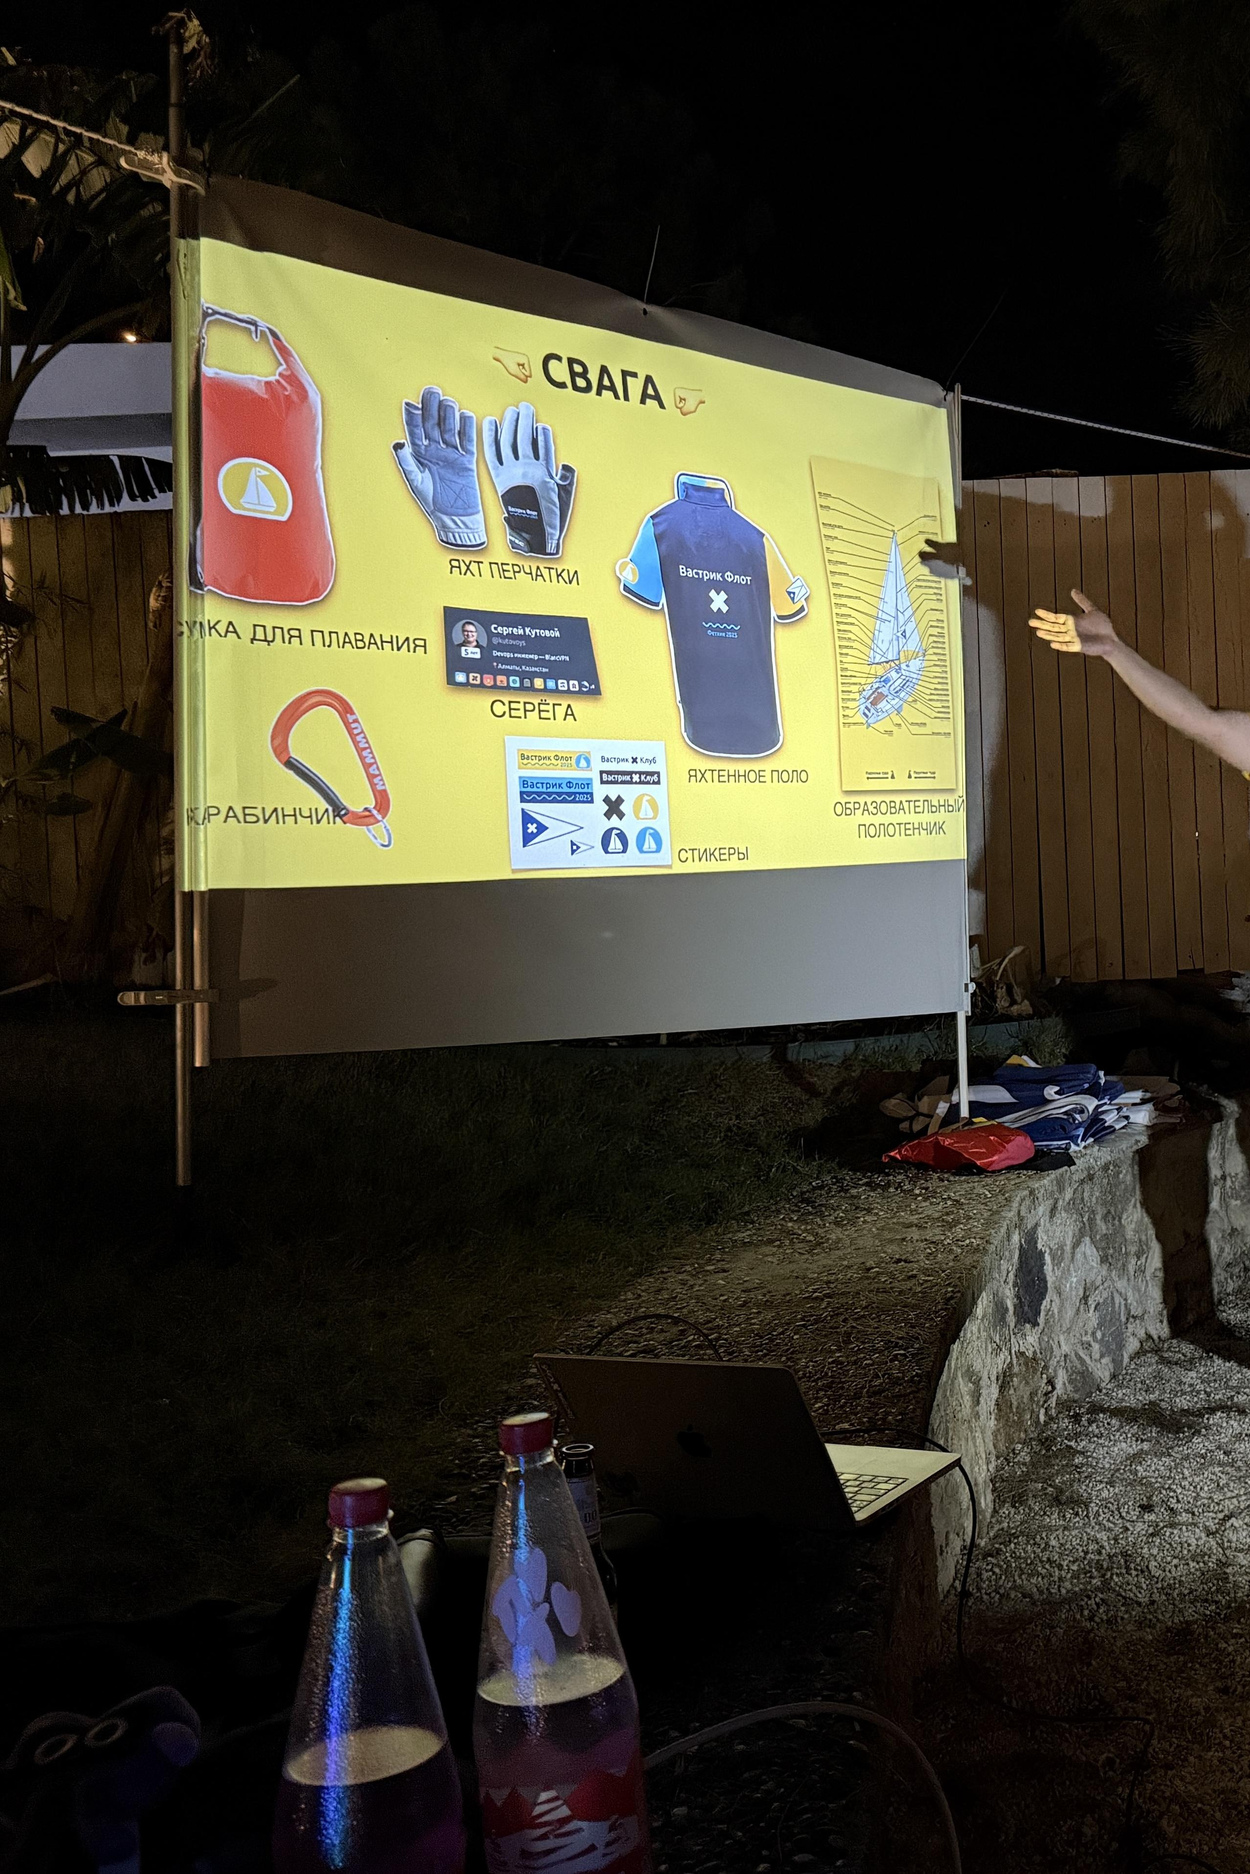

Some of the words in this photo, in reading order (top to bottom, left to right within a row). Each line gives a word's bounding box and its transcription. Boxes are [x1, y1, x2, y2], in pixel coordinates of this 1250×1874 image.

[541, 352, 667, 410] СВАГА
[449, 558, 484, 577] ЯХТ
[489, 561, 580, 586] ПЕРЧАТКИ
[679, 564, 723, 582] Вастрик
[724, 571, 752, 585] Флот
[250, 623, 303, 647] ДЛЯ
[310, 629, 427, 655] ПЛАВАНИЯ
[490, 623, 524, 636] Сергей
[525, 626, 560, 638] Кутовой
[490, 698, 577, 722] СЕРЁГА
[346, 713, 387, 790] MAMMUT
[520, 752, 552, 762] Вастрик
[553, 754, 573, 762] Флот
[601, 755, 629, 765] Вастрик
[639, 756, 657, 765] Клуб
[522, 779, 564, 791] Вастрик
[565, 780, 591, 791] Флот
[602, 773, 632, 783] Вастрик
[641, 773, 659, 784] Клуб
[687, 768, 767, 784] ЯХТЕННОЕ
[770, 769, 809, 784] ПОЛО
[833, 794, 964, 817] ОБРАЗОВАТЕЛЬНЫЙ
[858, 820, 947, 839] ПОЛОТЕНЧИК
[677, 846, 749, 864] СТИКЕРЫ
